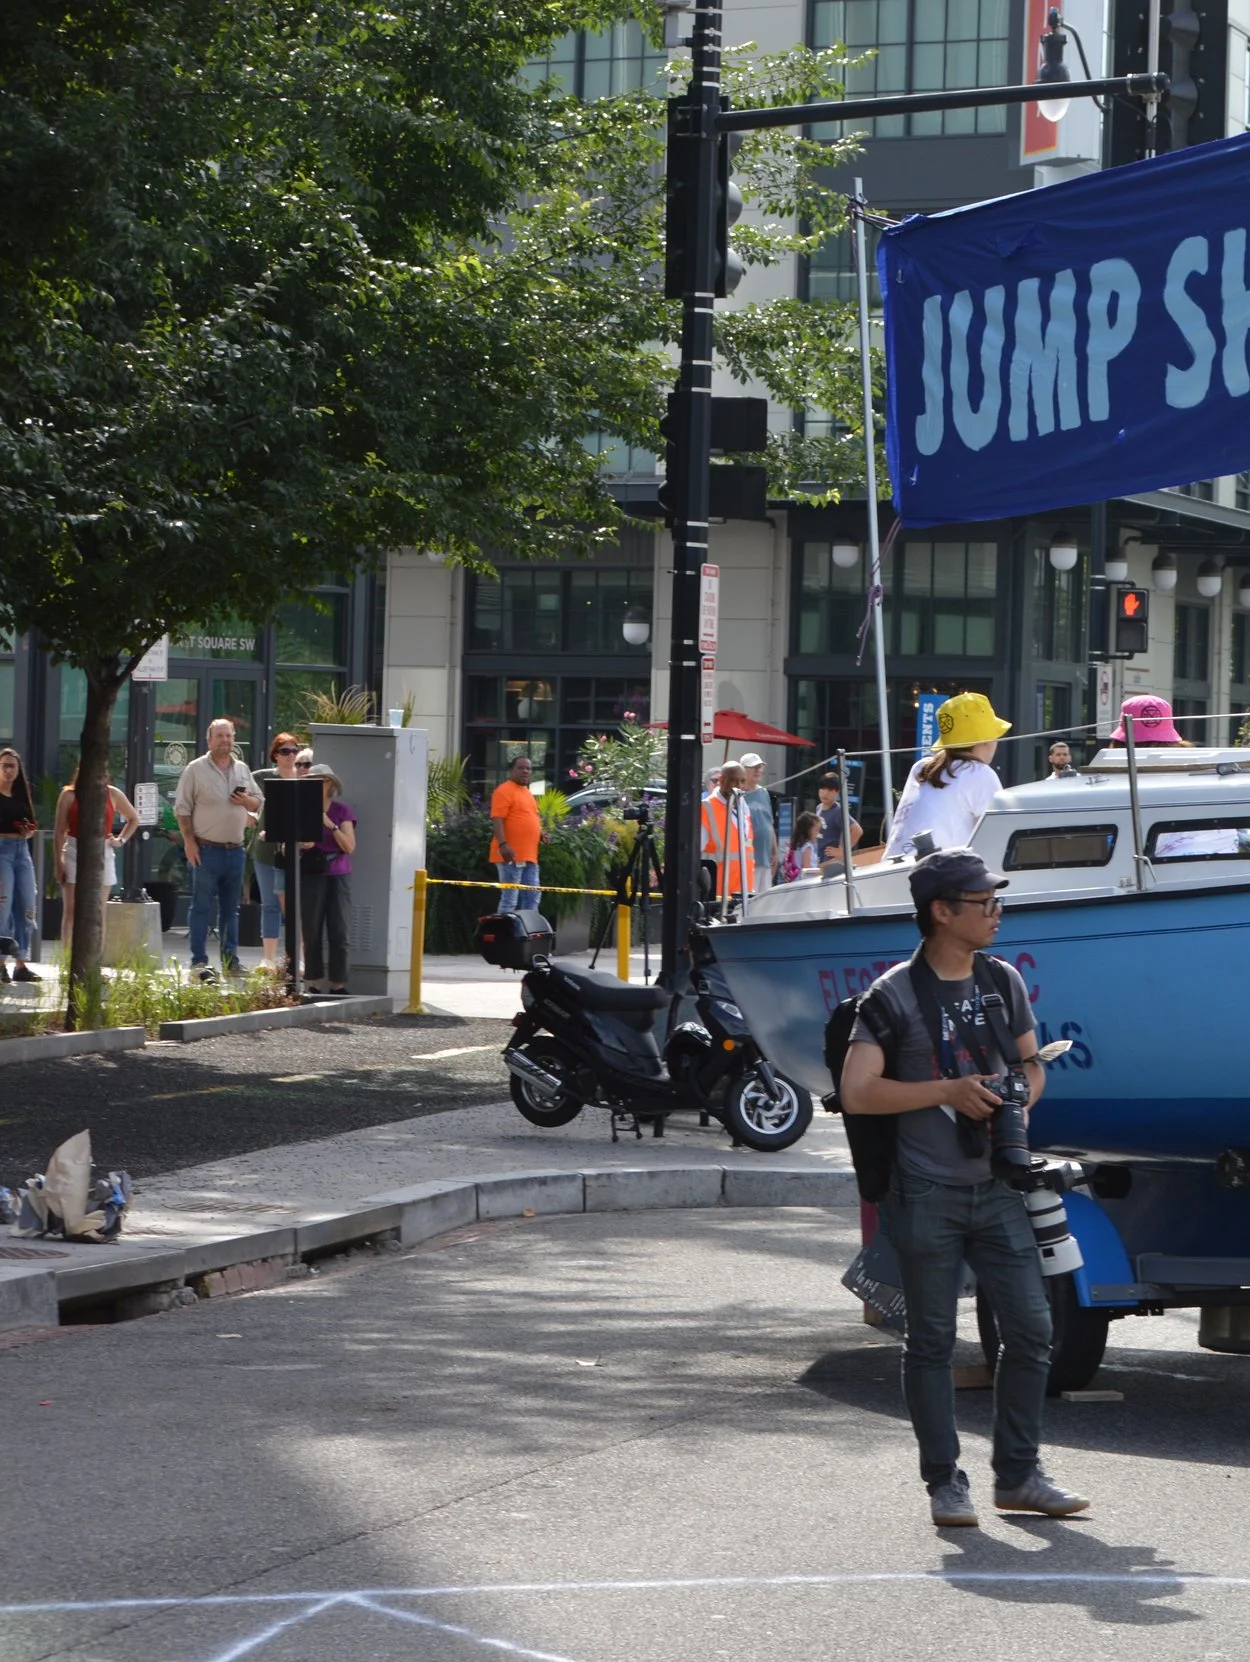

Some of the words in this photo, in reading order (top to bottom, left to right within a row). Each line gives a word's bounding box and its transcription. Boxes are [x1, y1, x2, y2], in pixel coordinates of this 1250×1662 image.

[915, 258, 1142, 456] JUMP
[197, 636, 237, 650] SQUARE
[239, 638, 256, 651] SW
